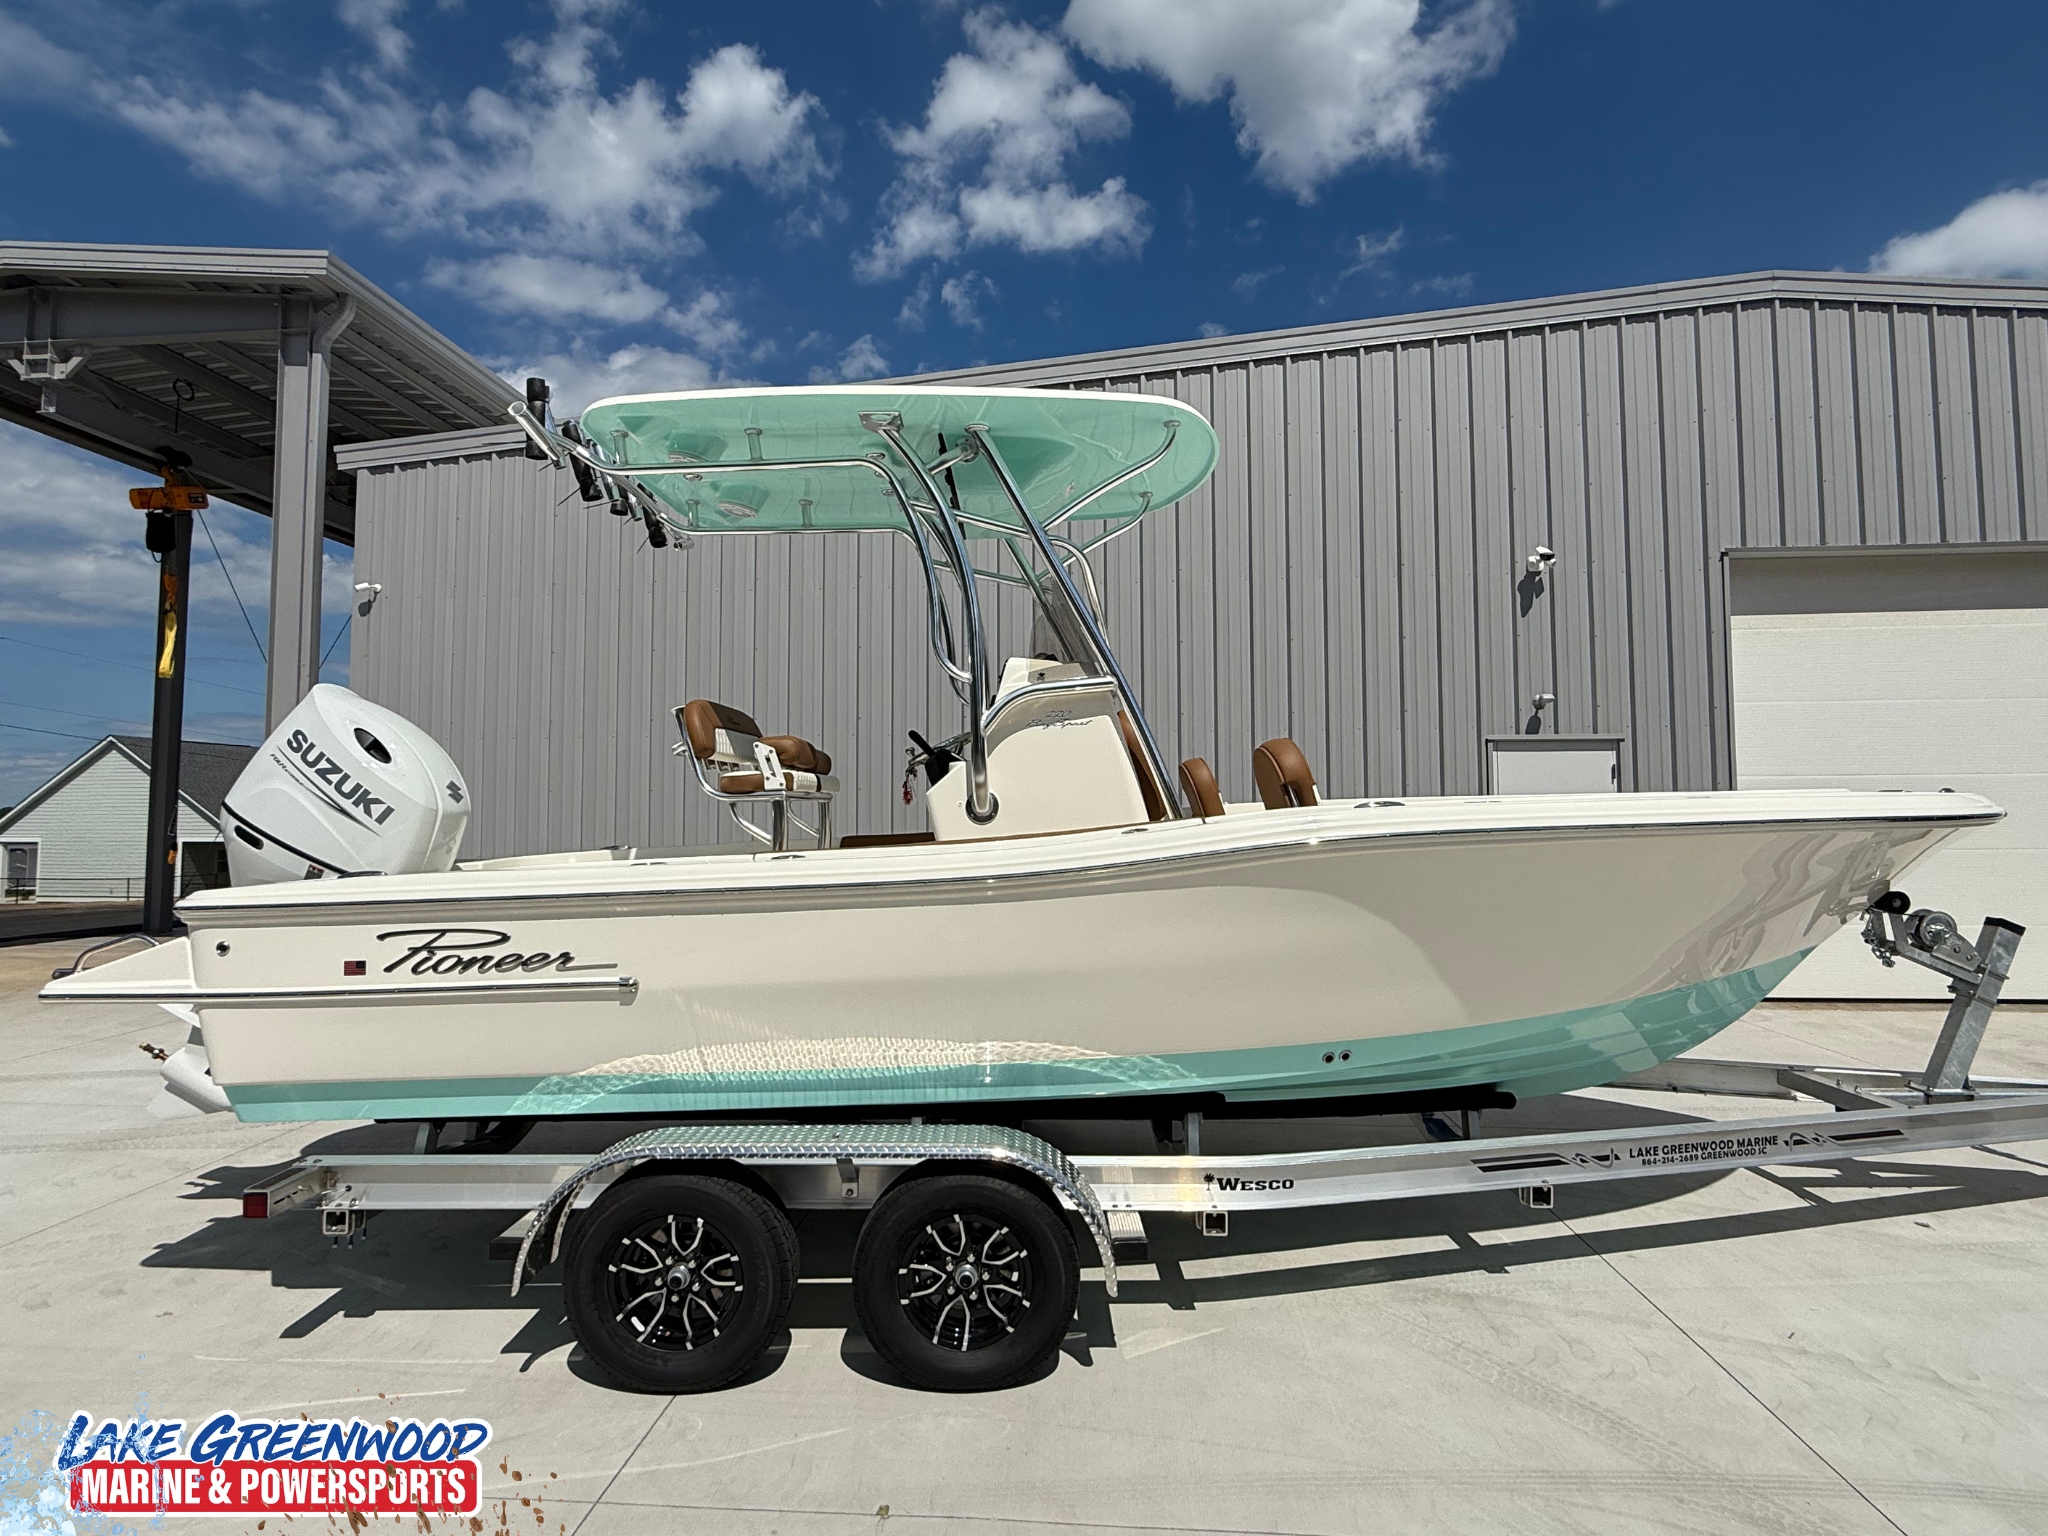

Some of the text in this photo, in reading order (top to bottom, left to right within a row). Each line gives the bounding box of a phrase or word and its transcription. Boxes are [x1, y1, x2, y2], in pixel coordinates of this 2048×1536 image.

[1045, 710, 1072, 718] 220
[286, 729, 395, 826] SUZUKI
[376, 928, 619, 976] Pioneer
[1629, 1135, 1778, 1158] LAKE GREENWOOD MARINE
[1641, 1146, 1768, 1166] 864-214-2689 GREENWOOD SC
[1216, 1177, 1295, 1191] WESCO
